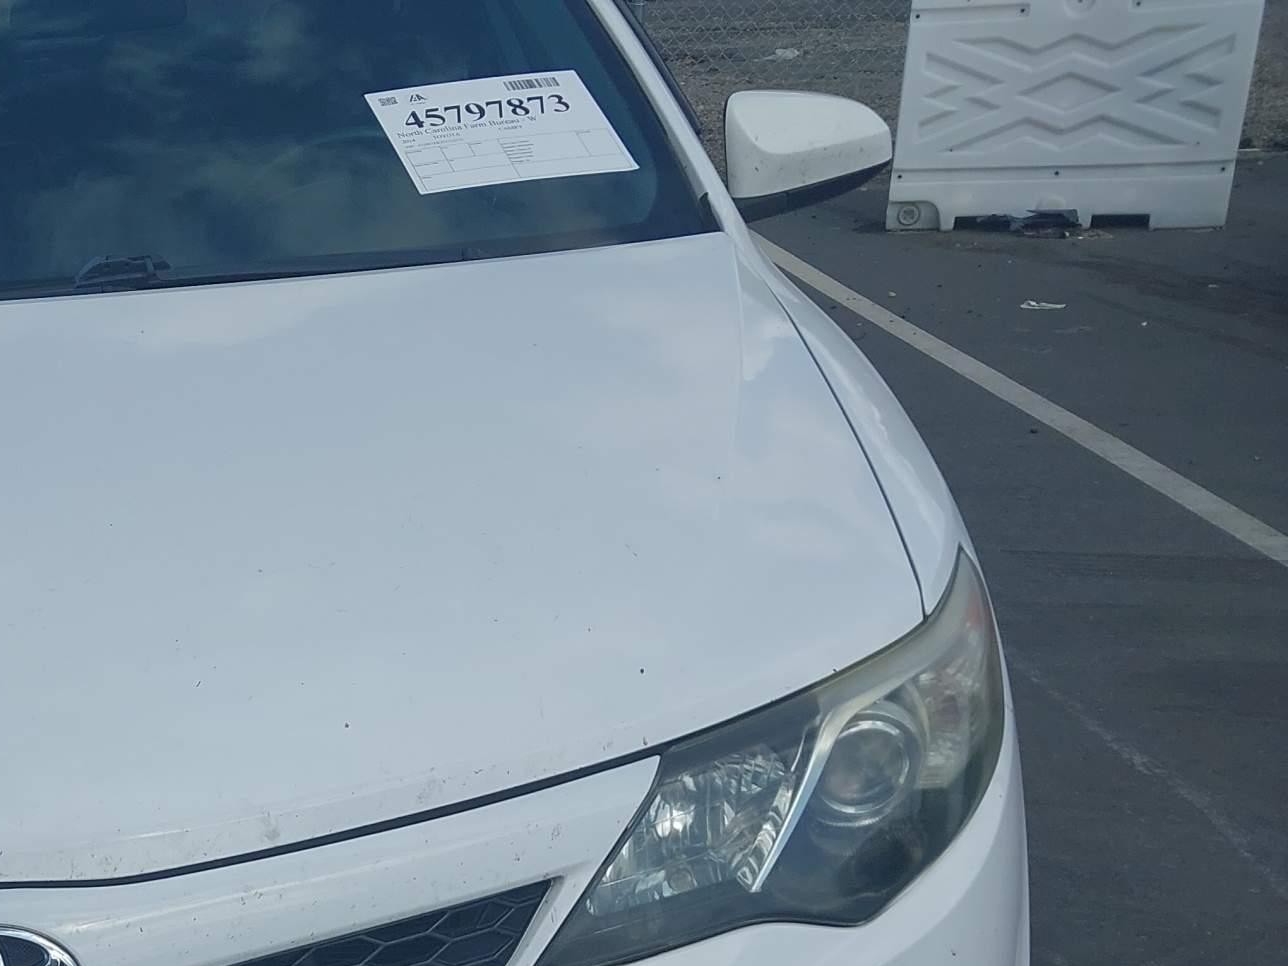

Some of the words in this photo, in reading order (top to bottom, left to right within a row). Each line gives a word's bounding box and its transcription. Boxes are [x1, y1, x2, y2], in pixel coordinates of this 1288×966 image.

[404, 94, 570, 129] 45797873
[397, 129, 424, 139] North
[425, 124, 462, 135] Carolina
[463, 120, 487, 131] Farm
[488, 117, 520, 127] Bureau
